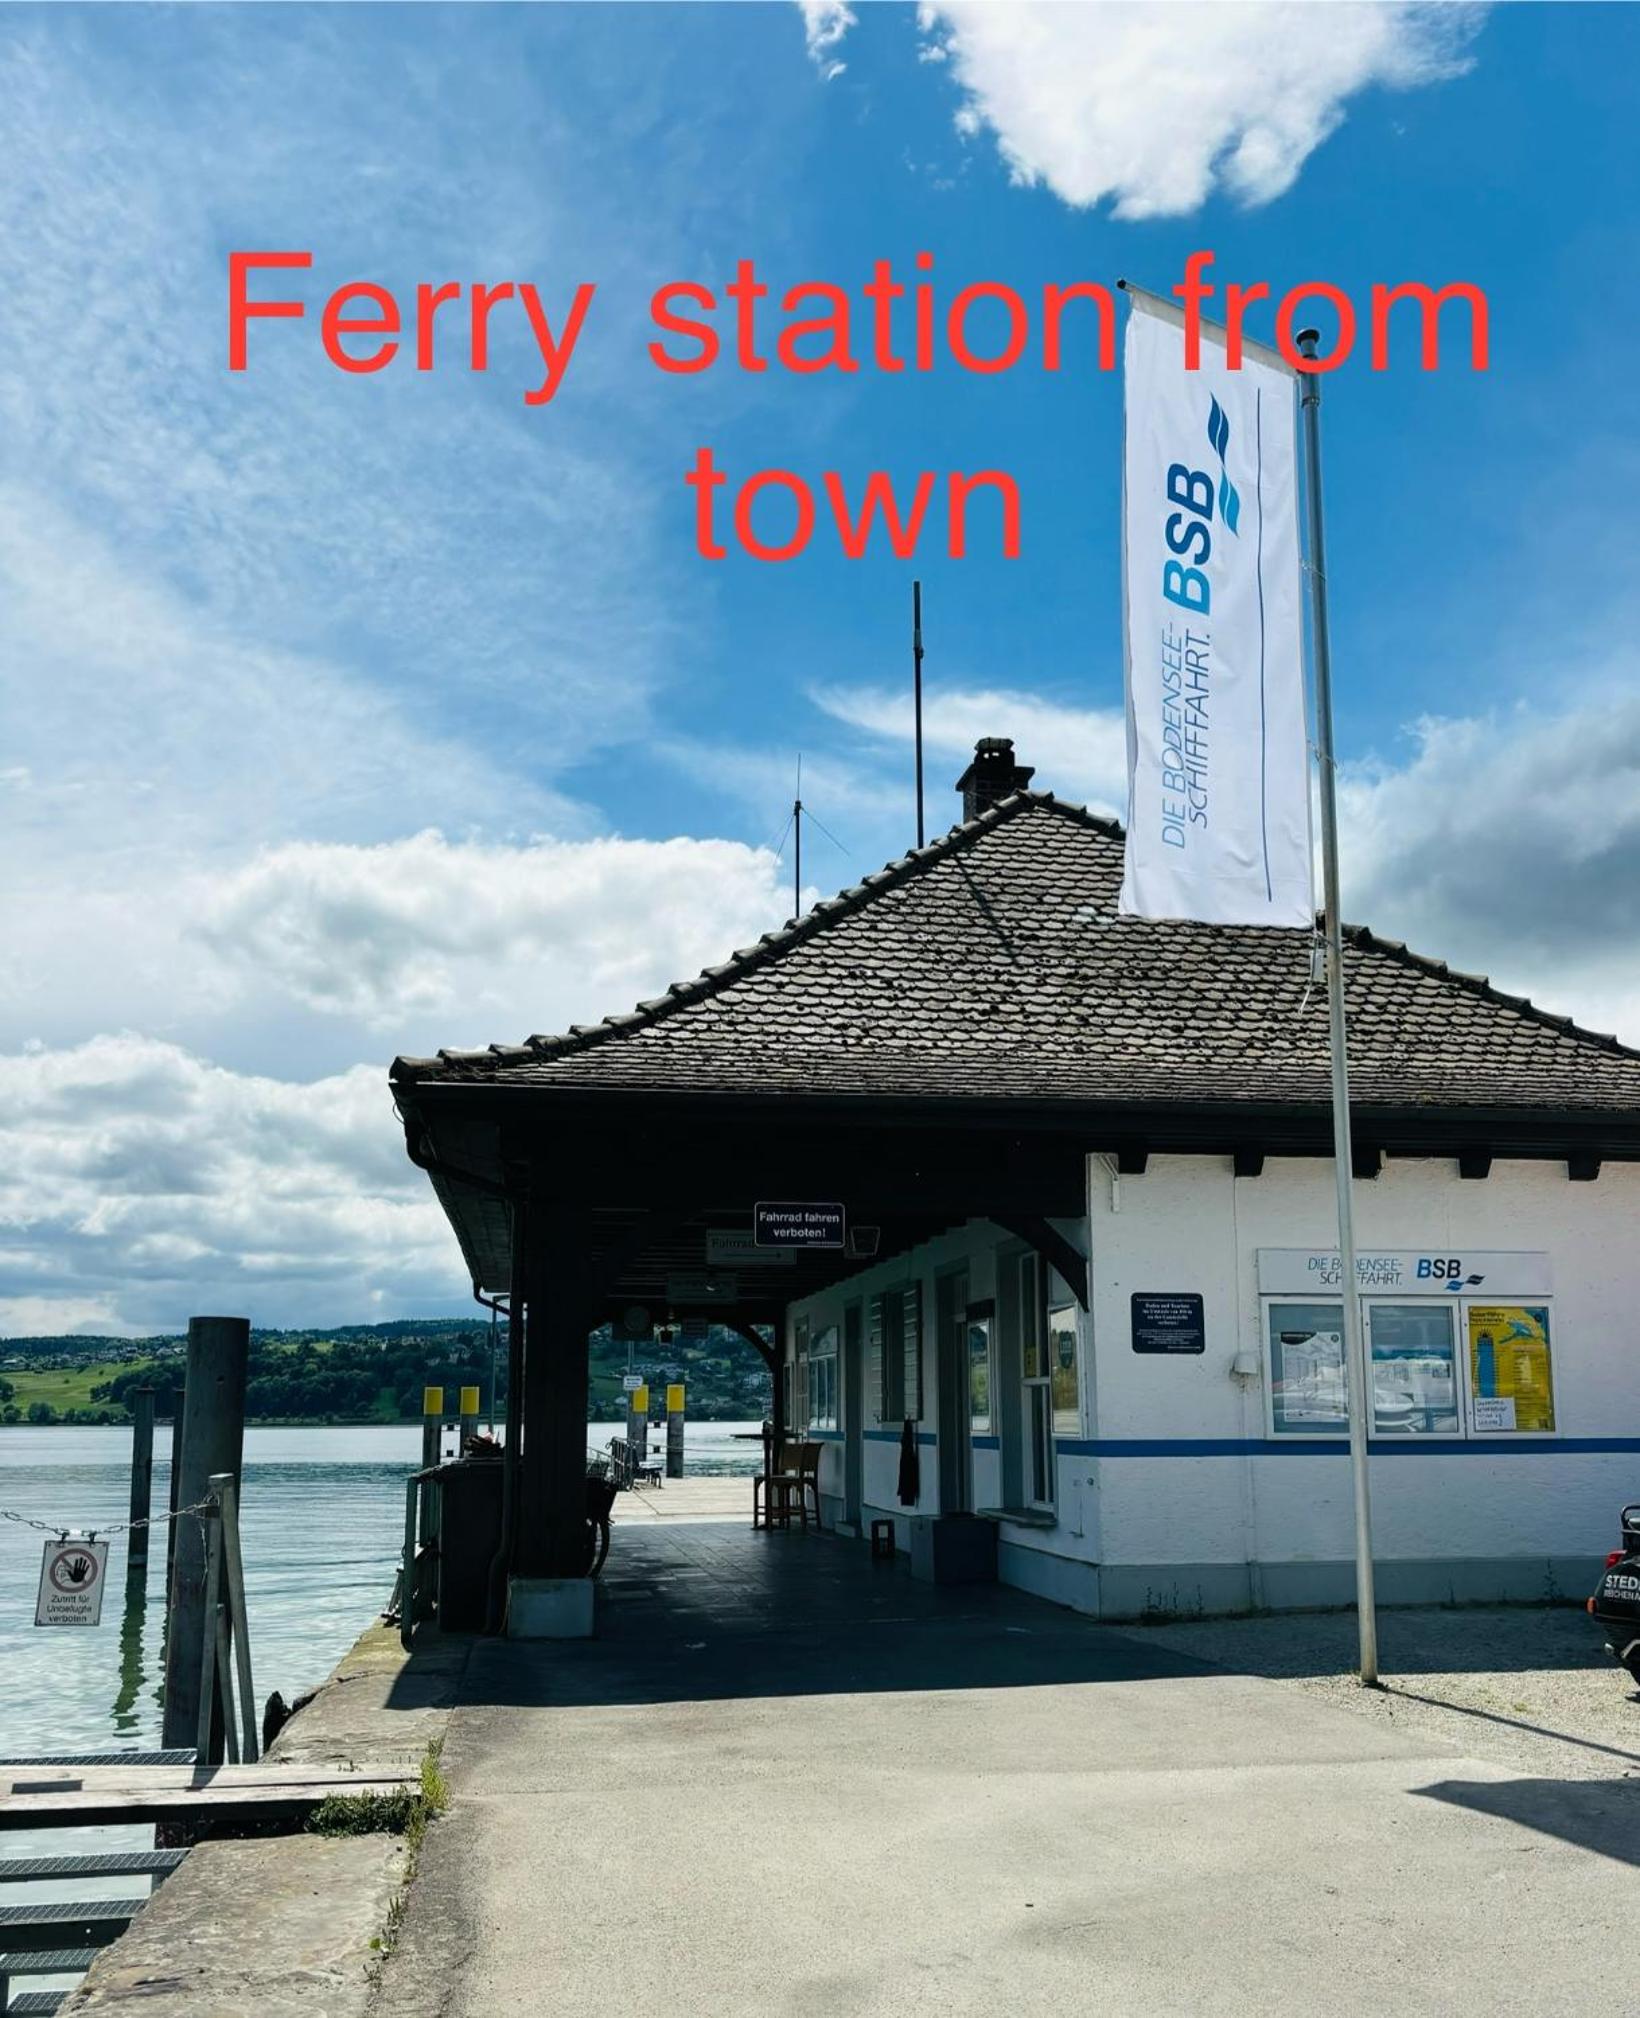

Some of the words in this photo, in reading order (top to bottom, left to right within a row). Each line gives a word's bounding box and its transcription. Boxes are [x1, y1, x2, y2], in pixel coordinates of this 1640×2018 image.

[1163, 463, 1215, 616] BSB
[1162, 621, 1186, 795] BODENSEE-
[1184, 628, 1211, 830] SCHIFFFAHRT.
[1162, 797, 1186, 850] DIE
[759, 1211, 803, 1223] Fahrrad
[804, 1212, 840, 1224] fahren
[773, 1227, 826, 1238] verboten!
[1308, 1257, 1328, 1271] DIE
[1331, 1257, 1403, 1272] BENSEE-
[1417, 1258, 1462, 1280] BSB
[1605, 1575, 1640, 1590] STED
